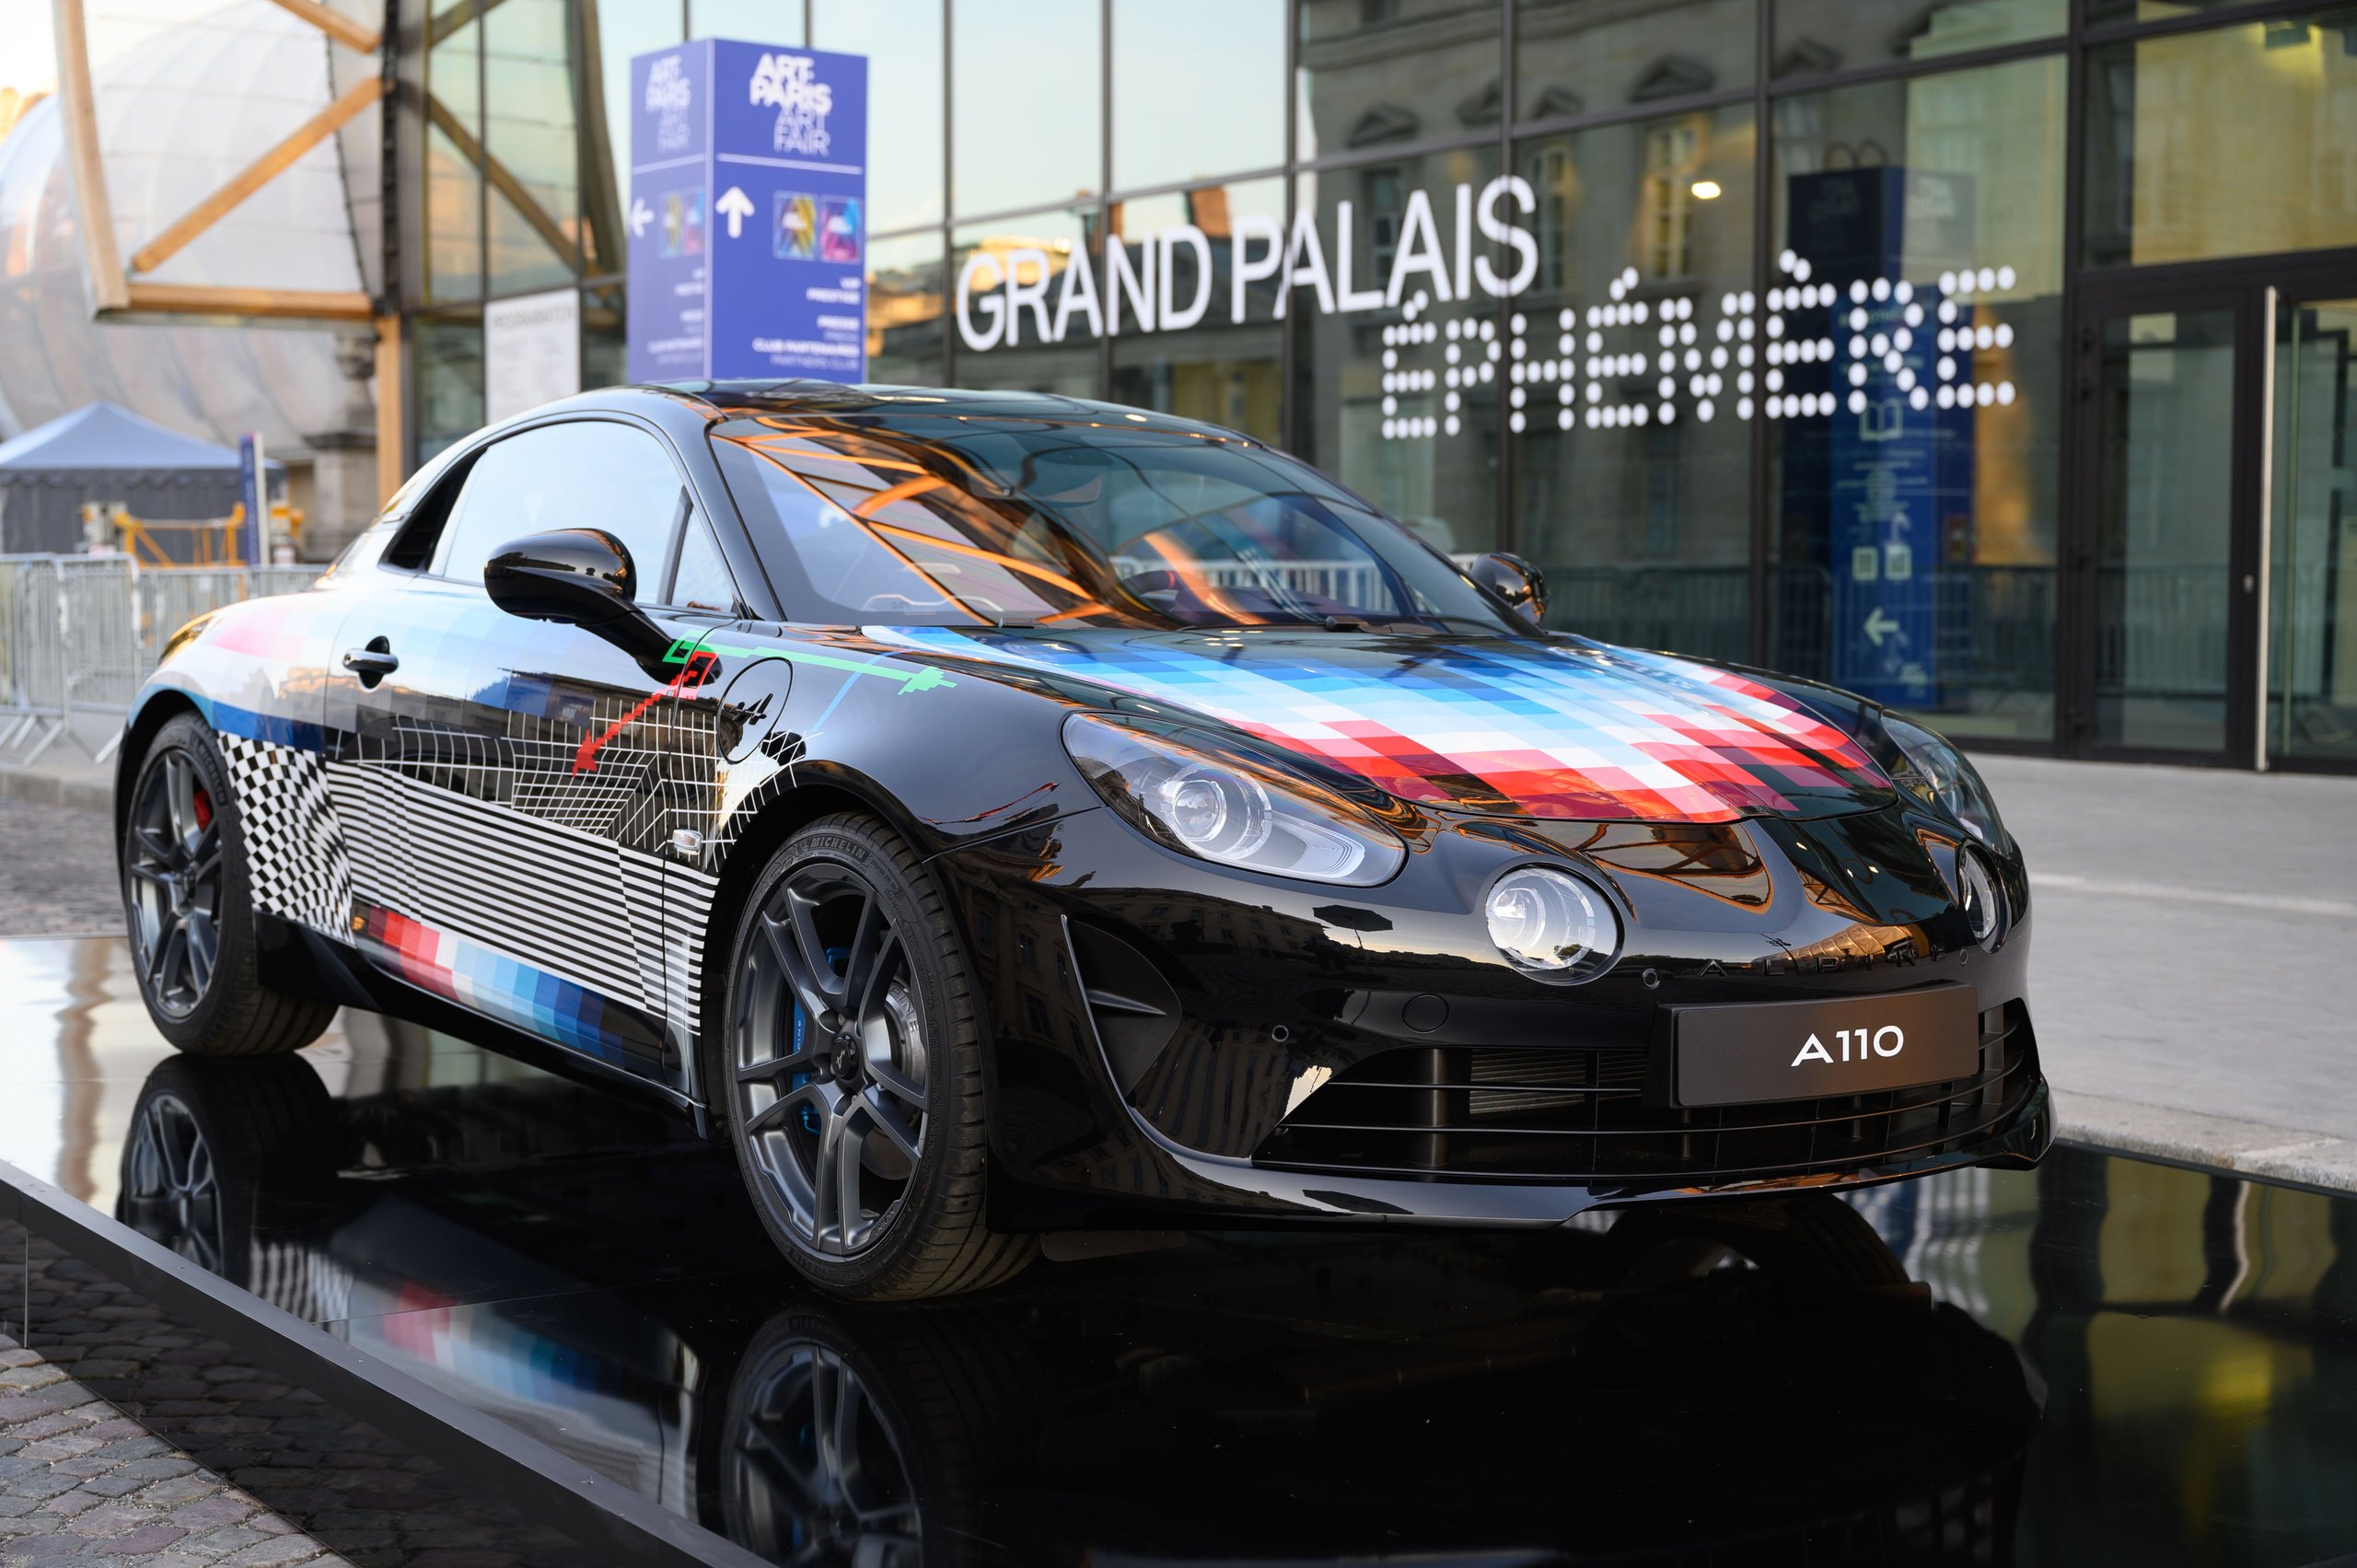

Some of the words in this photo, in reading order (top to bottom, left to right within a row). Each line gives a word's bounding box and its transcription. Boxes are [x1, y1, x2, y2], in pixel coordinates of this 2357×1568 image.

[751, 52, 815, 85] ART
[749, 75, 832, 116] PARIS
[774, 122, 830, 157] FAIR
[956, 225, 1213, 351] GRAND
[1231, 175, 1539, 324] PALAIS
[1382, 248, 2017, 440] ÉPHÉMÈRE
[809, 836, 865, 861] MICHELIN
[1699, 943, 1945, 977] ALPINE
[889, 987, 918, 1032] PINE
[1791, 1025, 1904, 1067] A110
